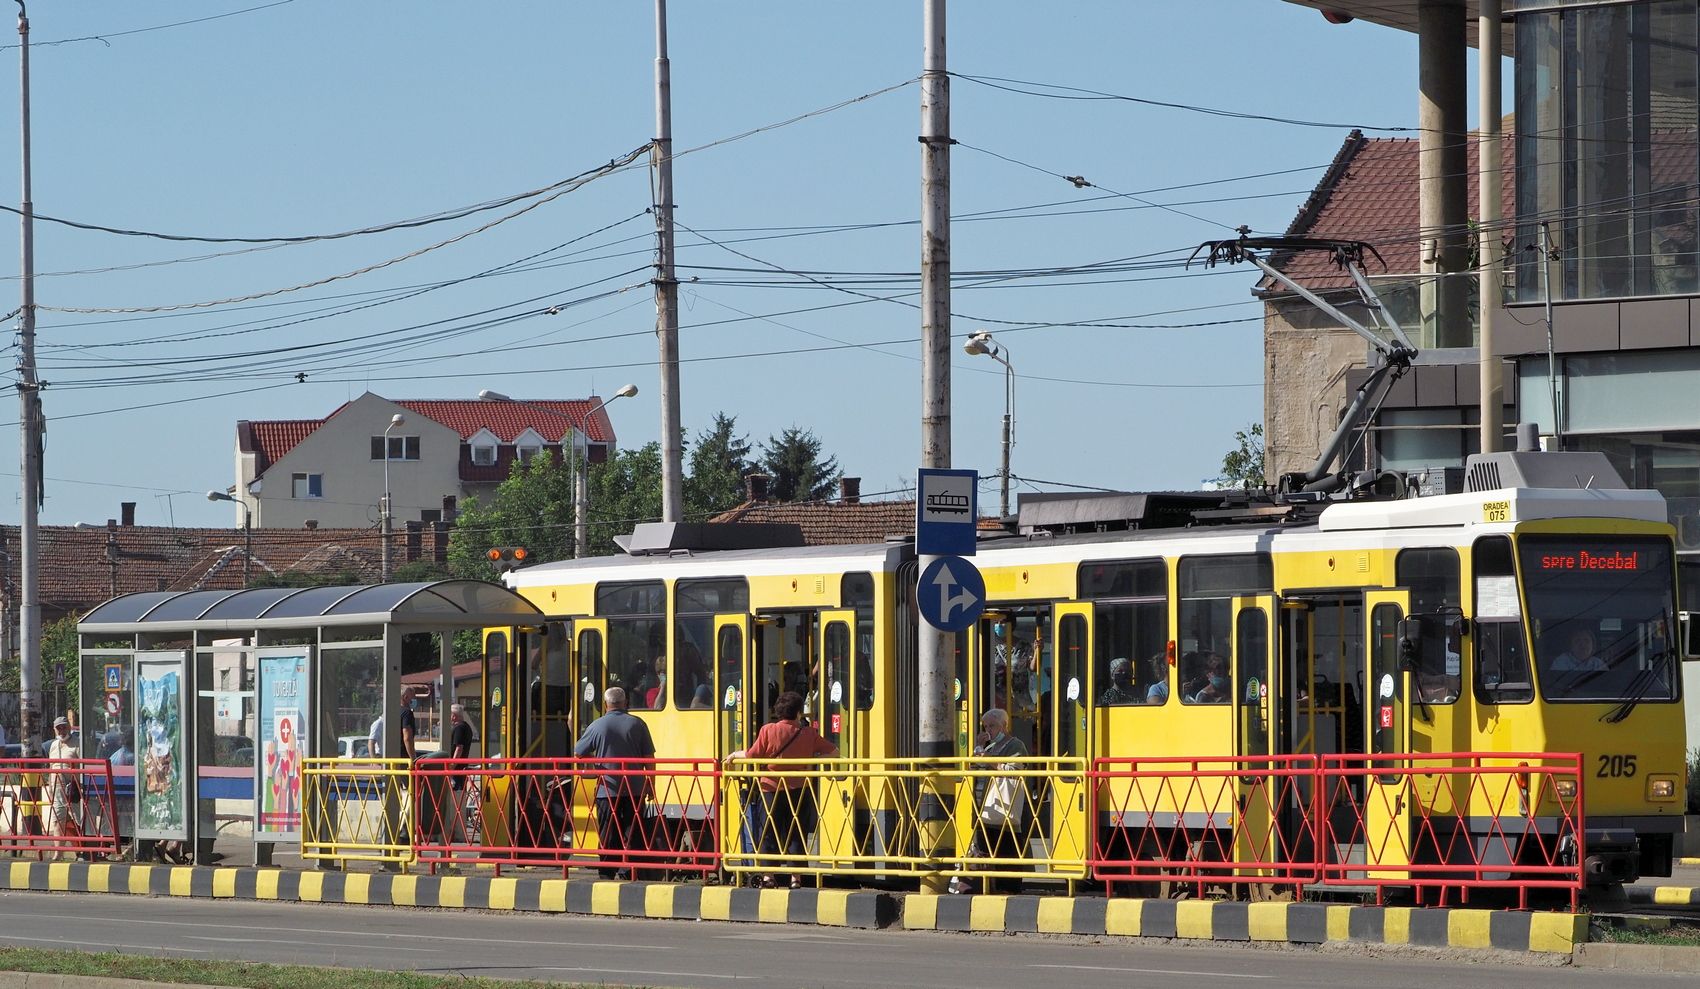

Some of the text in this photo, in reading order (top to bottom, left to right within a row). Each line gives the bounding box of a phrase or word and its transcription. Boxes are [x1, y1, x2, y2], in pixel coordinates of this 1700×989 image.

[1483, 501, 1508, 511] ORADEA
[1490, 510, 1505, 521] 075
[1542, 551, 1637, 569] spre Decebal
[1597, 754, 1637, 778] 205
